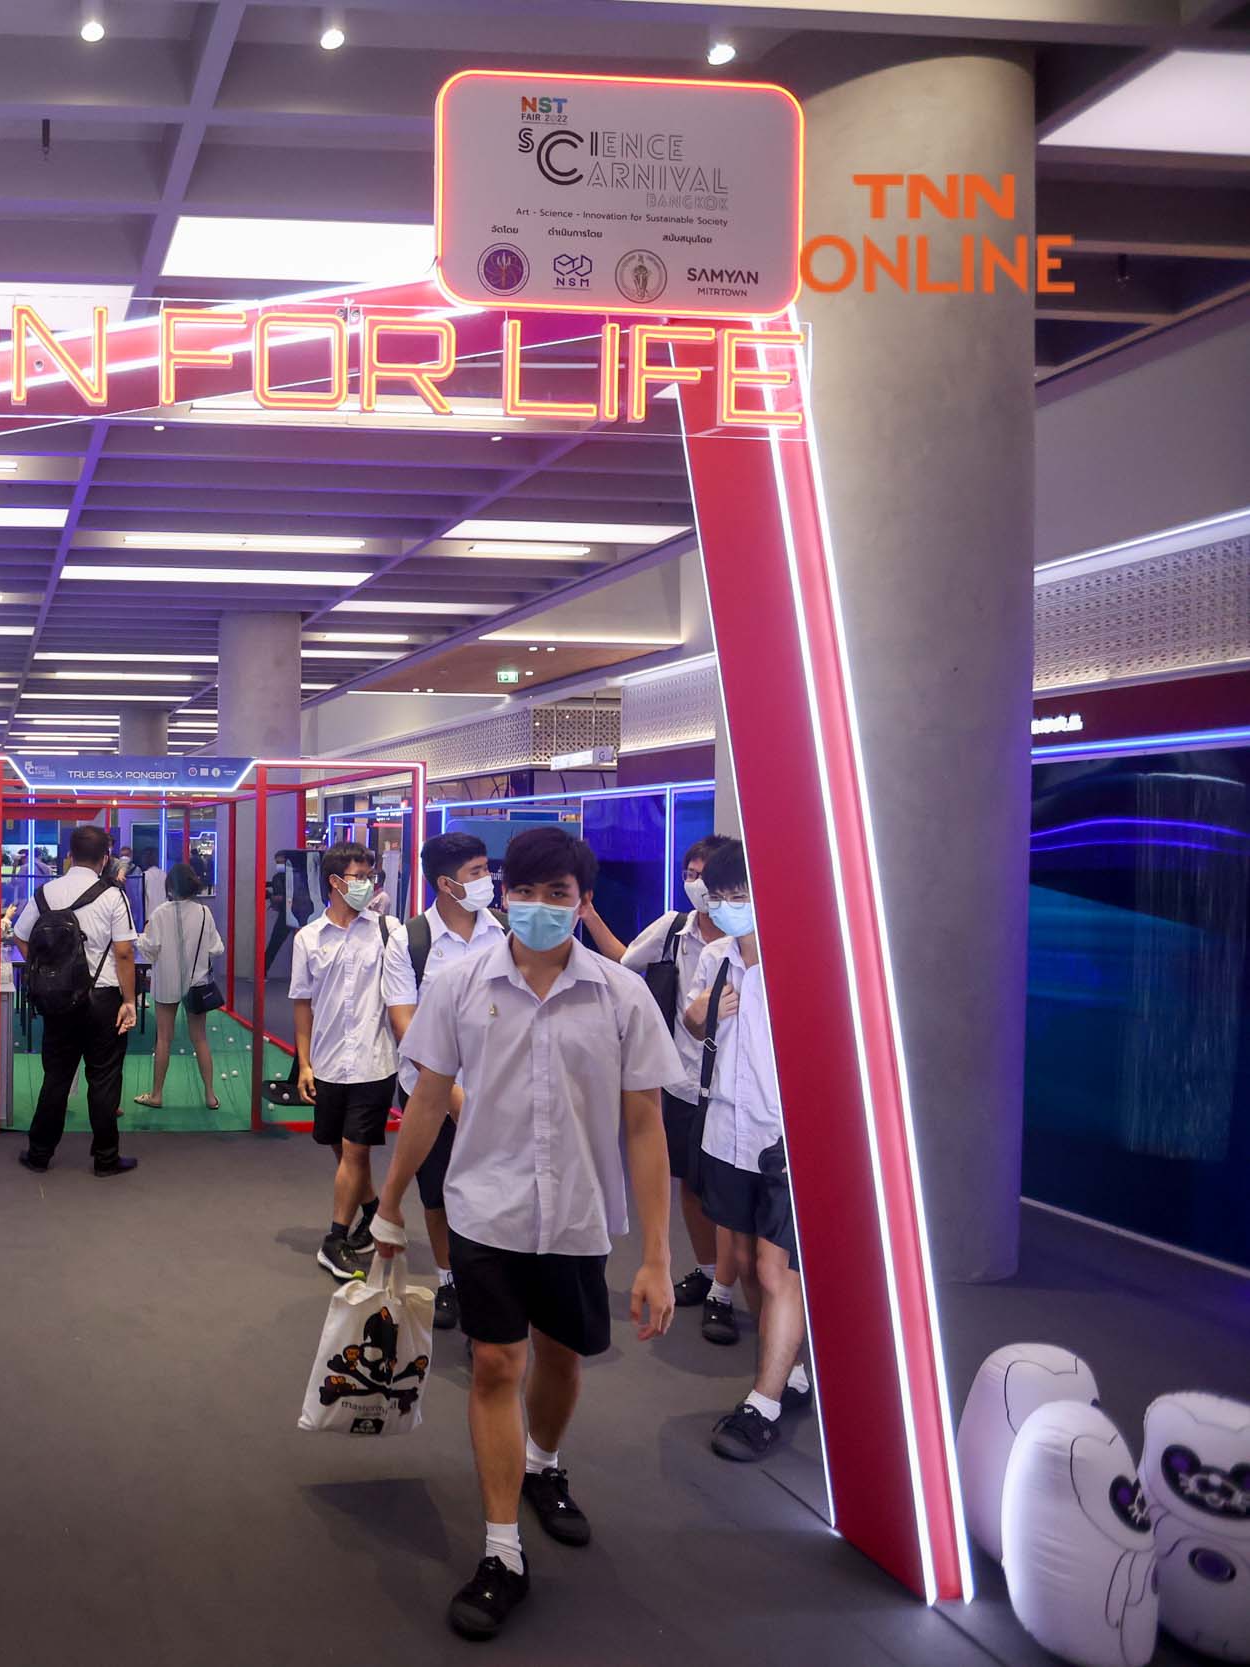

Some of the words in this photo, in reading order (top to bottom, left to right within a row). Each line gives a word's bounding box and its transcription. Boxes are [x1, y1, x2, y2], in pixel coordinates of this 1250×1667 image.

[521, 96, 568, 113] NST
[521, 113, 541, 121] FAIR
[518, 127, 684, 178] SCIENCE
[647, 193, 729, 211] BANGKOK
[516, 207, 529, 216] Art
[540, 208, 573, 218] Science
[583, 211, 627, 221] Innovation
[630, 213, 642, 222] for
[646, 214, 694, 224] Sustainable
[697, 216, 728, 227] Society
[556, 277, 590, 287] NSM
[687, 267, 759, 285] SAMYAN
[697, 287, 748, 297] MITRTOWN
[159, 307, 455, 415] FOR
[503, 318, 805, 427] LIFE
[67, 770, 96, 779] TRUE
[125, 771, 177, 780] PONGBOT
